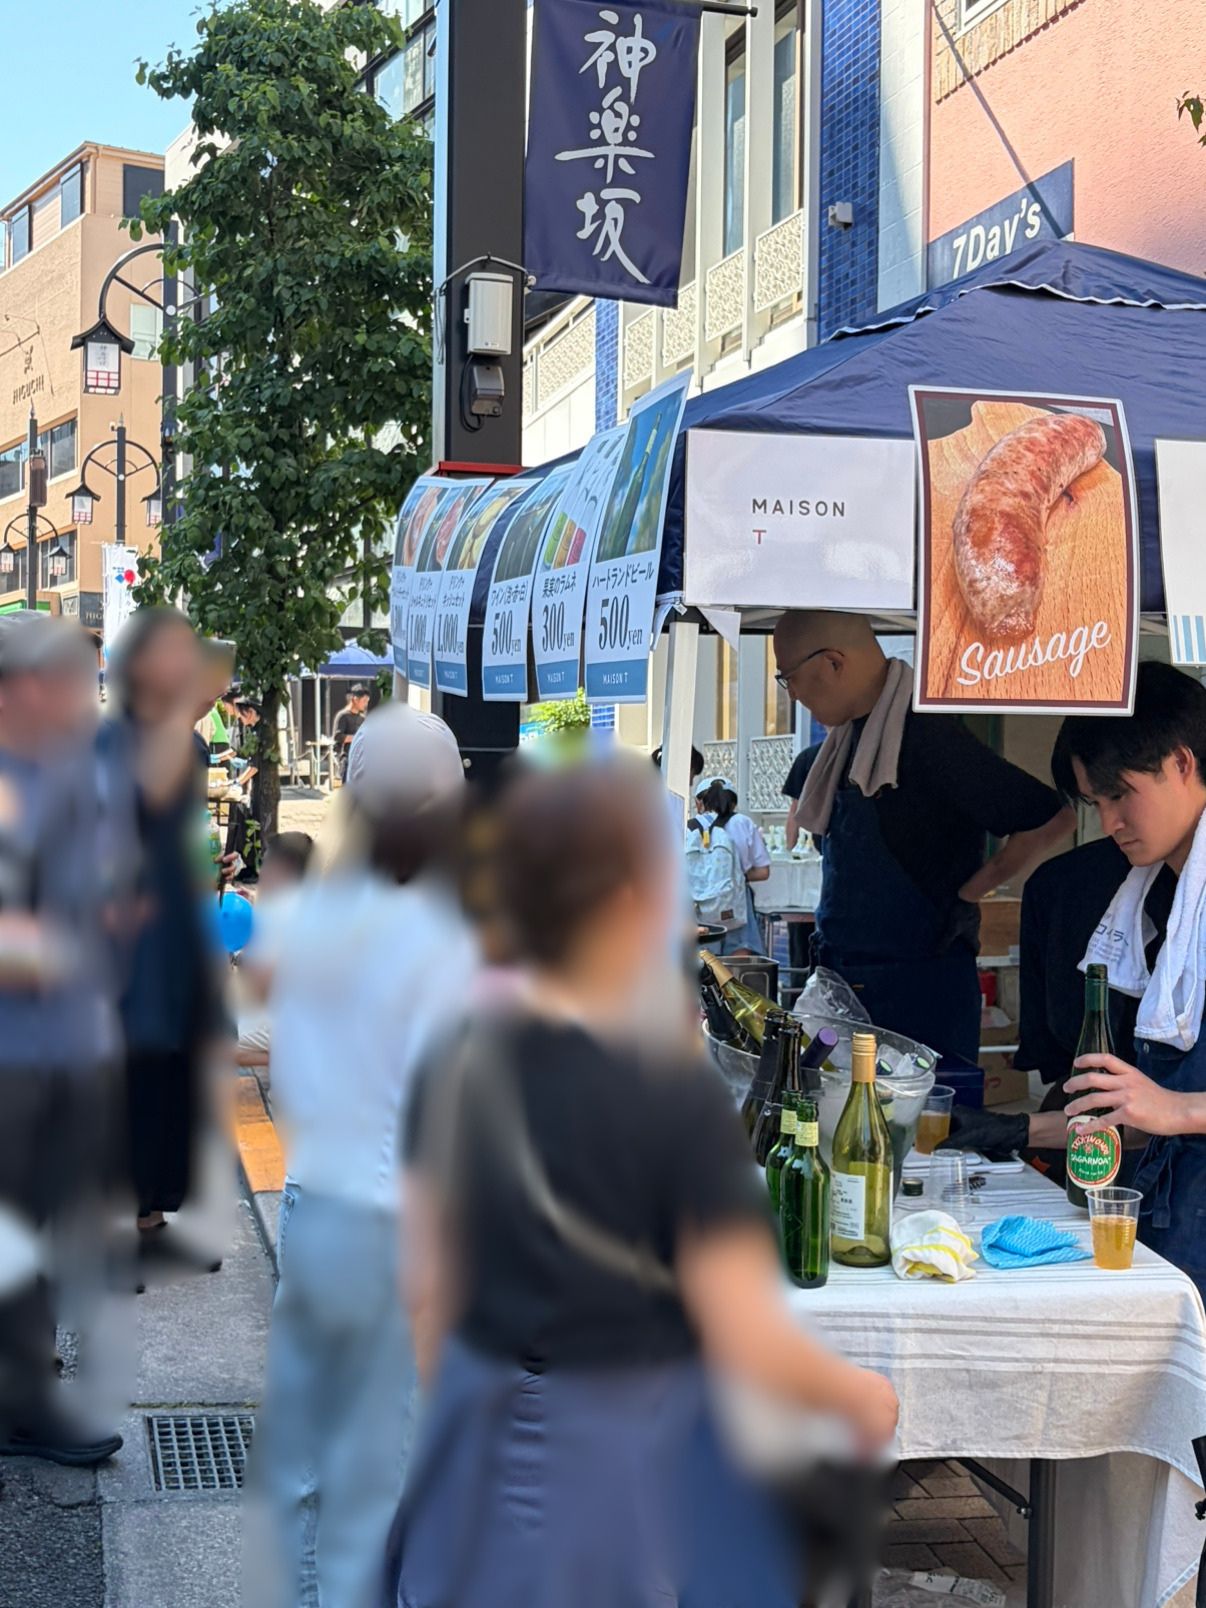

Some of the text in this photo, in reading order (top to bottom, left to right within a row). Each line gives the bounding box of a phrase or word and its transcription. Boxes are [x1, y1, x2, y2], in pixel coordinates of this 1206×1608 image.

[554, 10, 656, 285] 神楽坂
[952, 197, 1042, 280] 7Day's
[752, 498, 845, 517] MAISON
[752, 529, 767, 545] T
[542, 571, 577, 598] 果実のラムネ
[592, 561, 655, 591] ハートランドビール
[956, 620, 1113, 687] Sausage
